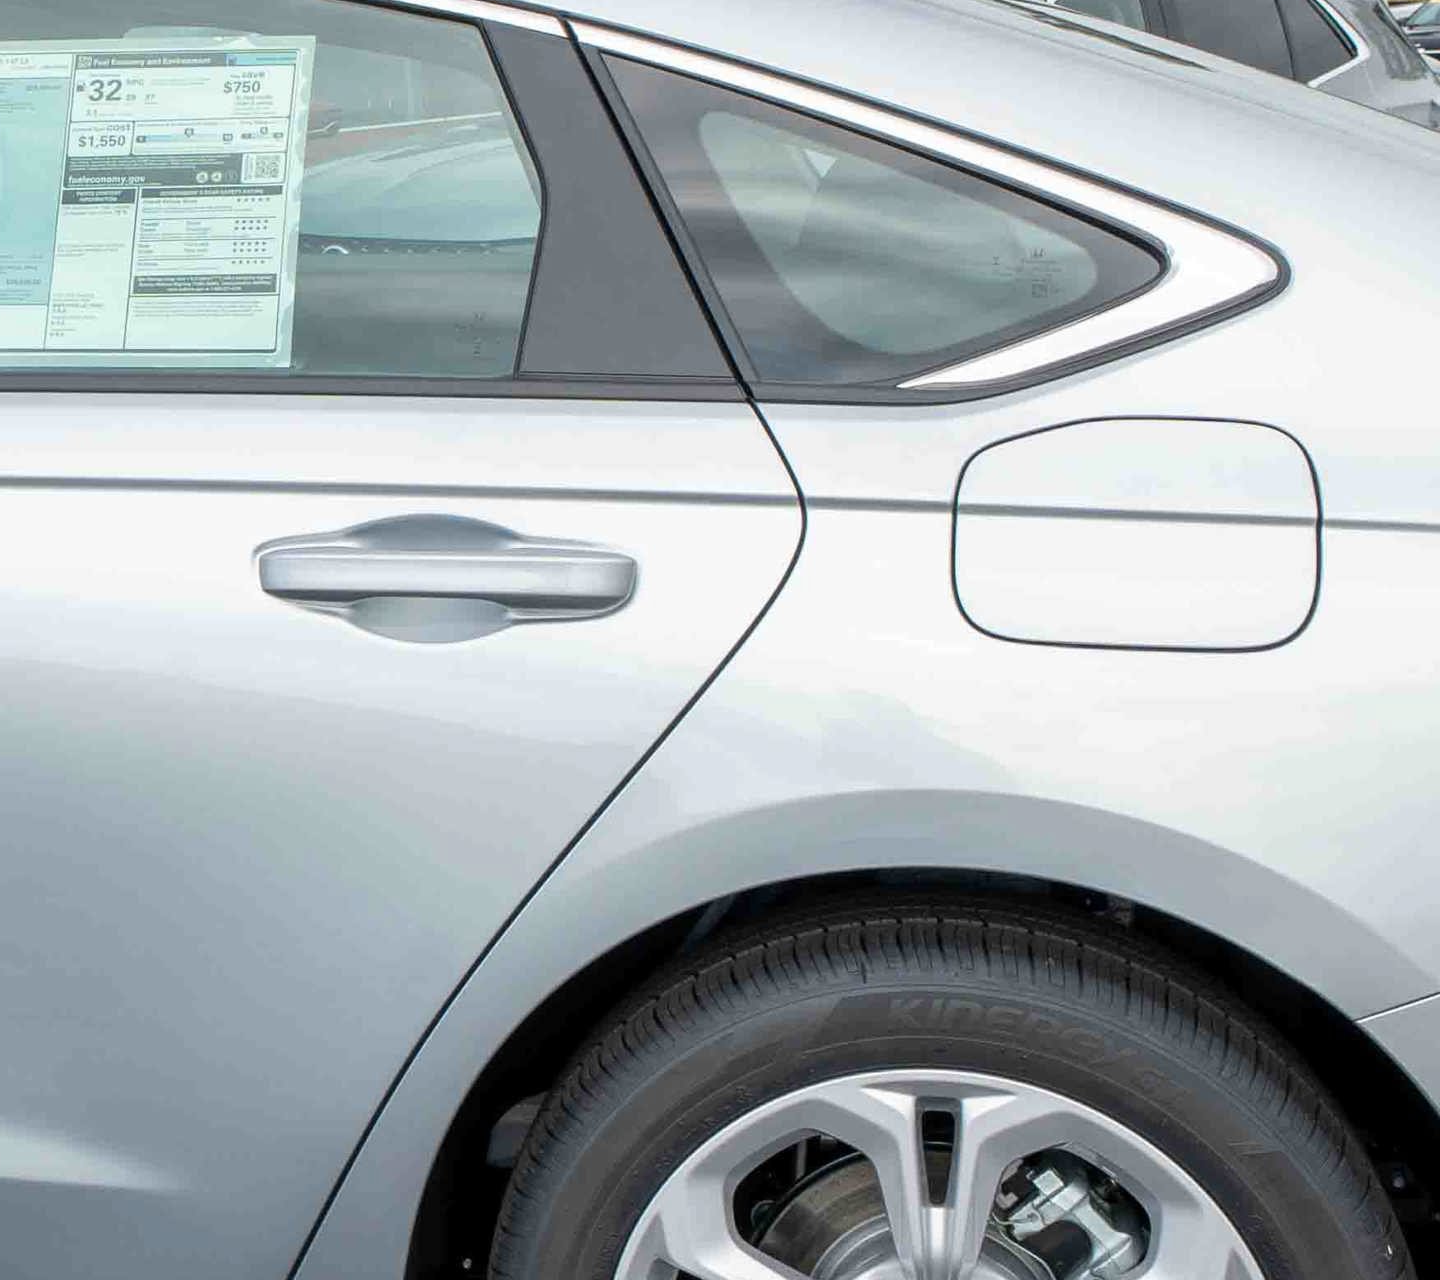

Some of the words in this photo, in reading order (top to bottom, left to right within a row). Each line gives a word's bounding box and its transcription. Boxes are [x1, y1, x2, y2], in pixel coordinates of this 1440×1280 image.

[92, 58, 110, 67] Fuel
[111, 57, 145, 67] Economy
[146, 57, 161, 66] and
[163, 56, 212, 66] Environment
[88, 78, 123, 102] 32
[223, 80, 261, 94] $750
[78, 134, 126, 149] $1,550
[68, 175, 146, 186] fueleconomy.gov
